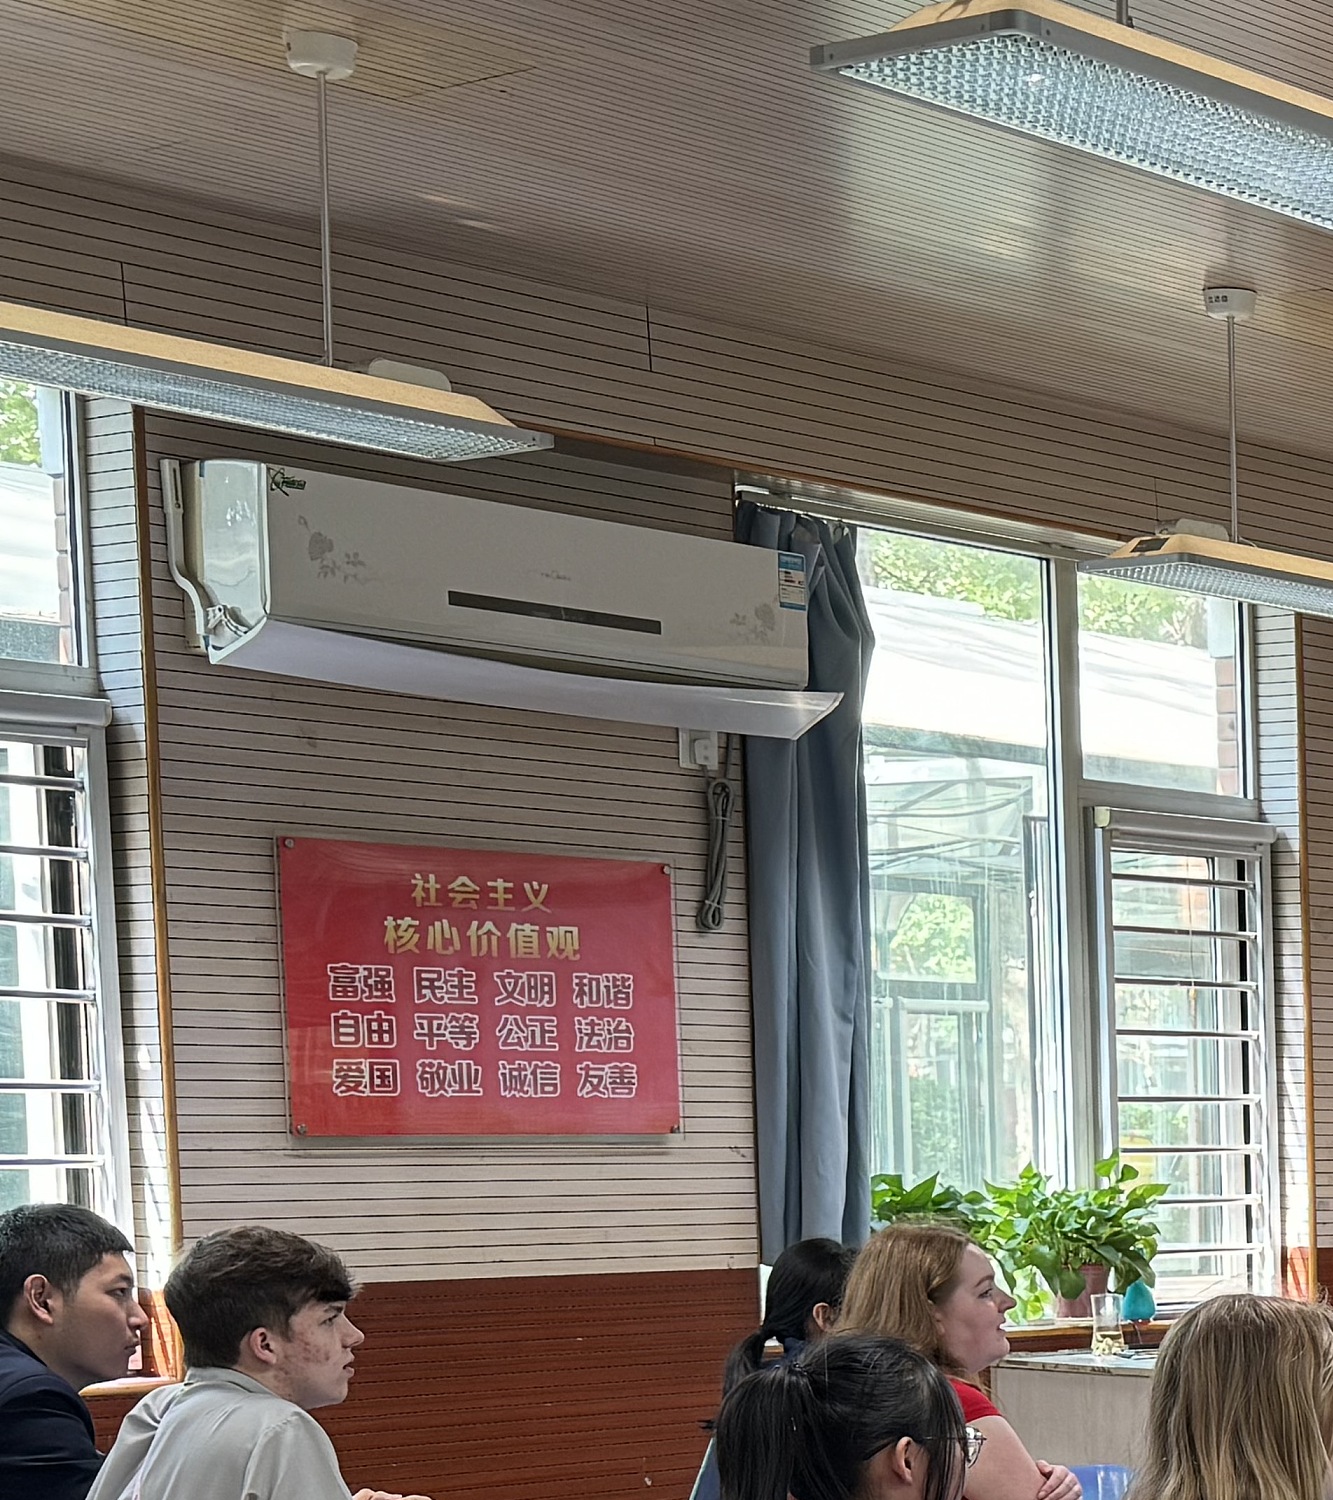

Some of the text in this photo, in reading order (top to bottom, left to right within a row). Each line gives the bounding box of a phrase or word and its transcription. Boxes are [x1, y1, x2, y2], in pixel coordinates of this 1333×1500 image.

[411, 873, 552, 913] 社会主义
[384, 915, 581, 961] 核心价值观
[327, 963, 633, 1009] 富强 民主 文明 和谐
[331, 1010, 634, 1053] 自由 平等 公正 法治
[333, 1059, 638, 1098] 爱国 敬业 诚信 友善
